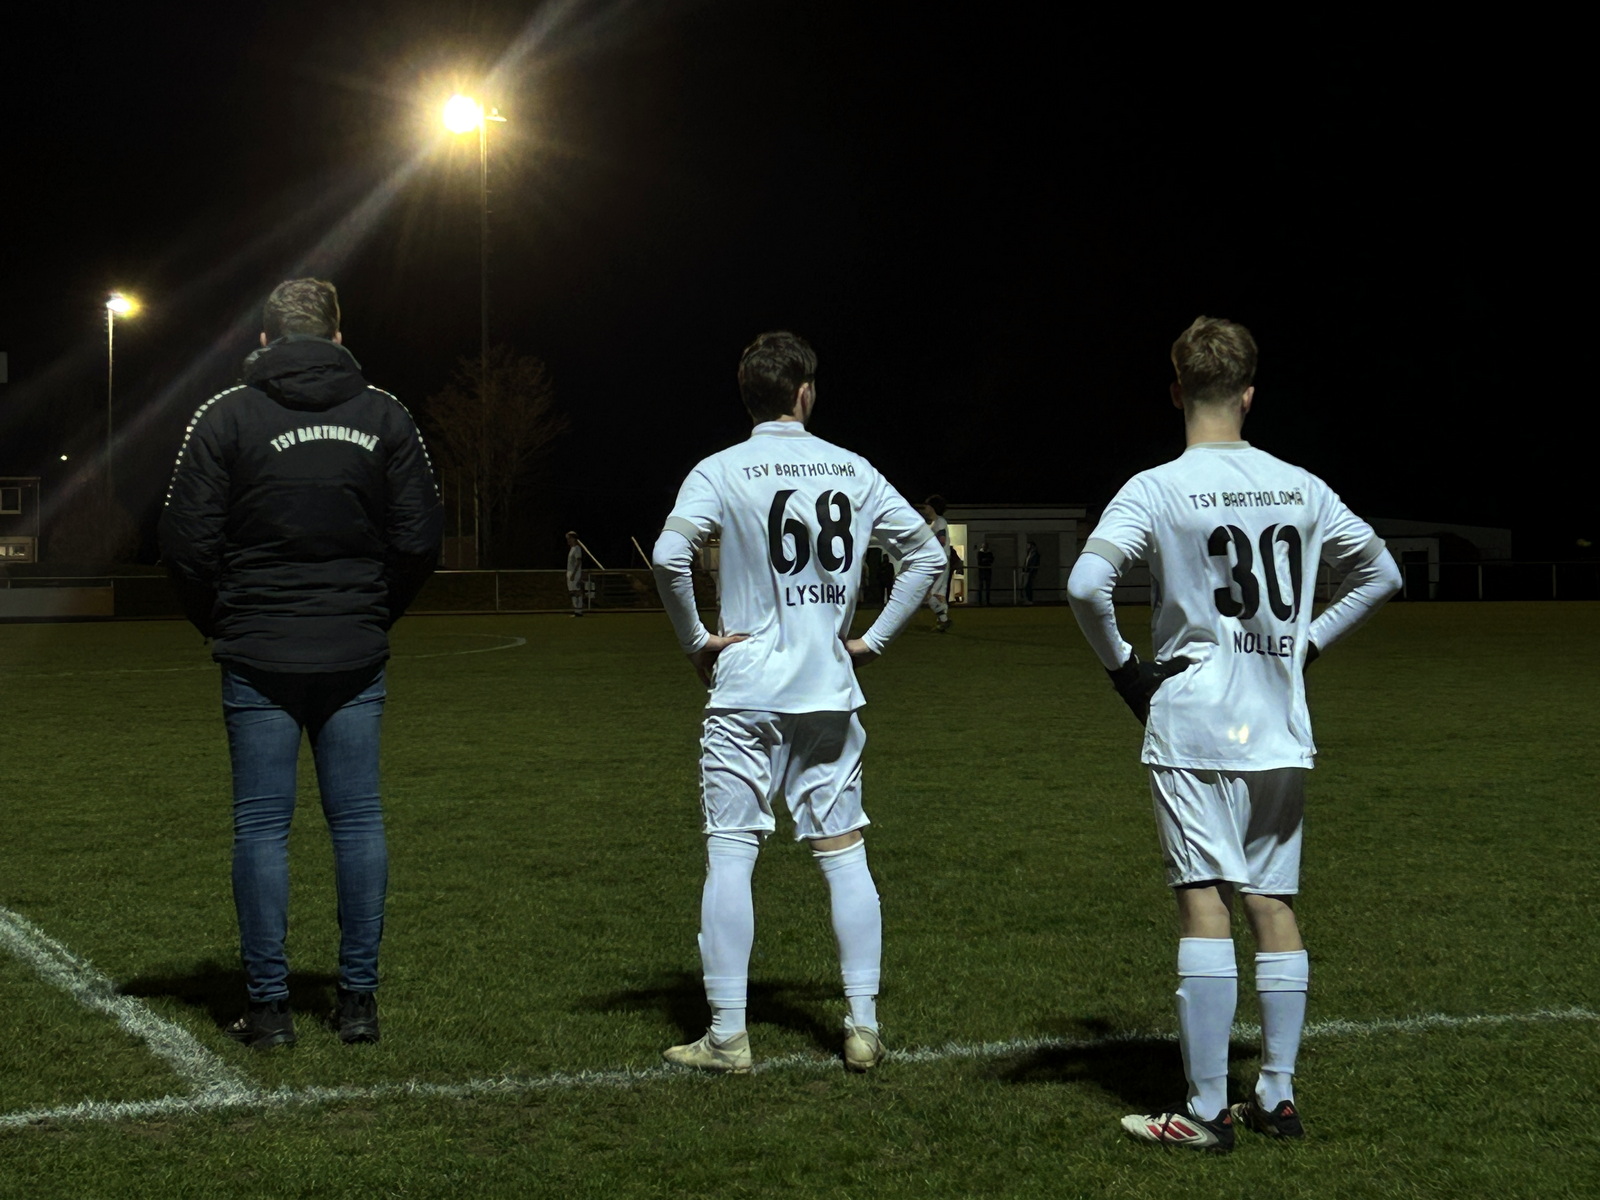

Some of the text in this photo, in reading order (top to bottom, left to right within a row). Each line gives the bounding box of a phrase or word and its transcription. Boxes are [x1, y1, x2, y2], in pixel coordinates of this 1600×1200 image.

[270, 431, 296, 452] TSV
[743, 461, 856, 480] TSV BARTHOLOMÄ
[1188, 486, 1305, 510] TSV BARTHOLOMÄ
[768, 489, 853, 576] 68
[1207, 522, 1302, 624] 30
[785, 584, 846, 606] LYSIAK
